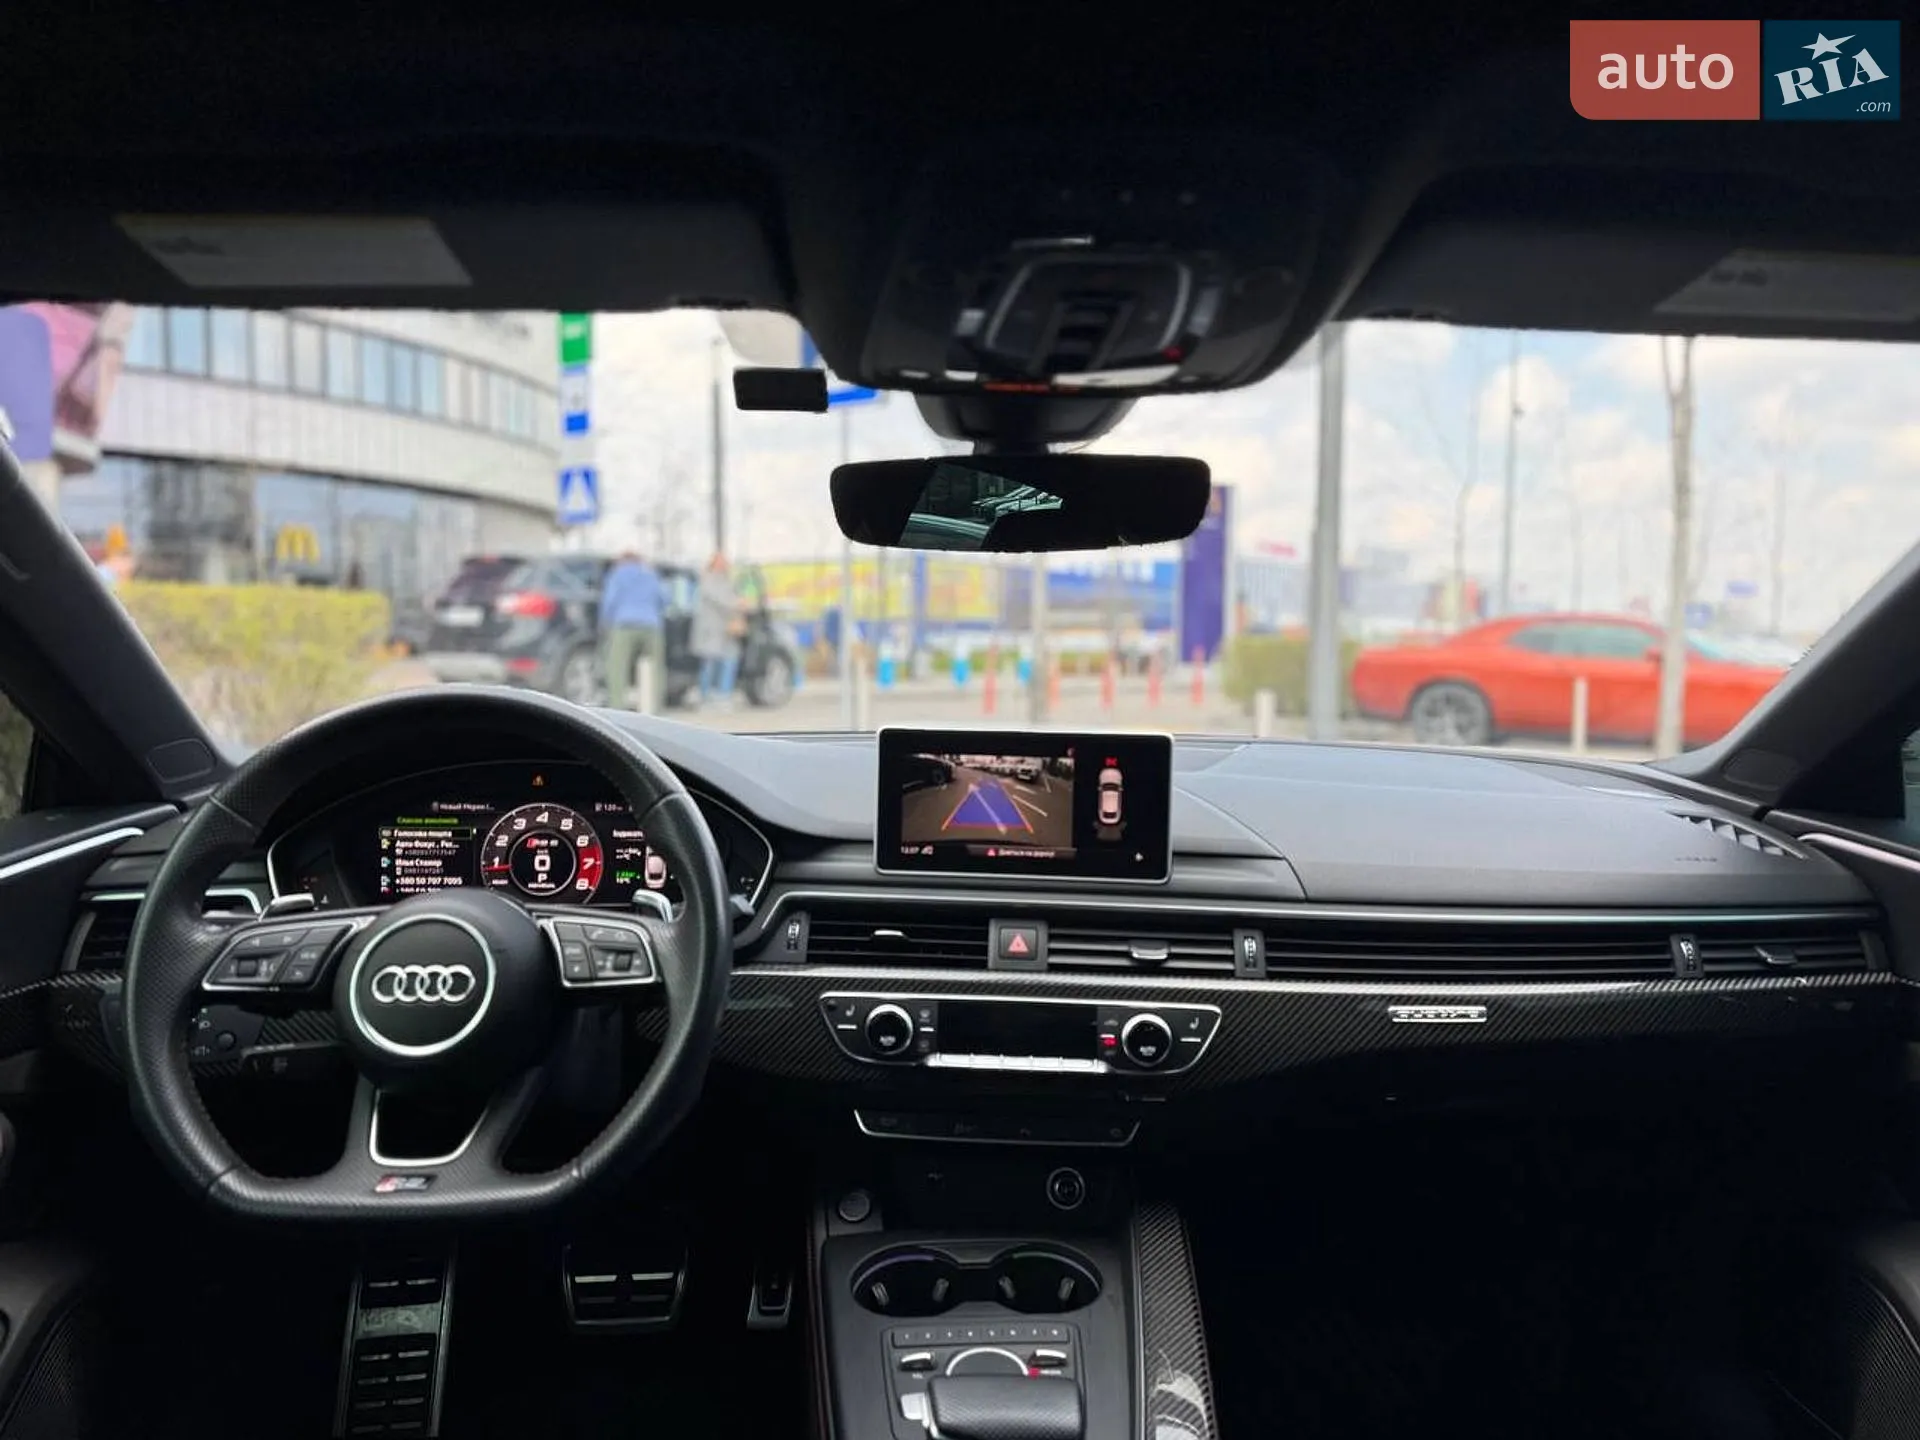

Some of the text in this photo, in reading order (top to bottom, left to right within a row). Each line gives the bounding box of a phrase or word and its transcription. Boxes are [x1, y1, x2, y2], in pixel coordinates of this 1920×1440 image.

[535, 811, 549, 823] 4
[512, 818, 527, 830] 3
[560, 818, 573, 830] 5
[495, 834, 509, 847] 2
[576, 834, 589, 847] 6
[492, 856, 500, 868] 1
[534, 854, 551, 871] 0
[582, 857, 595, 870] 7
[537, 872, 548, 883] P
[575, 877, 589, 890] 8
